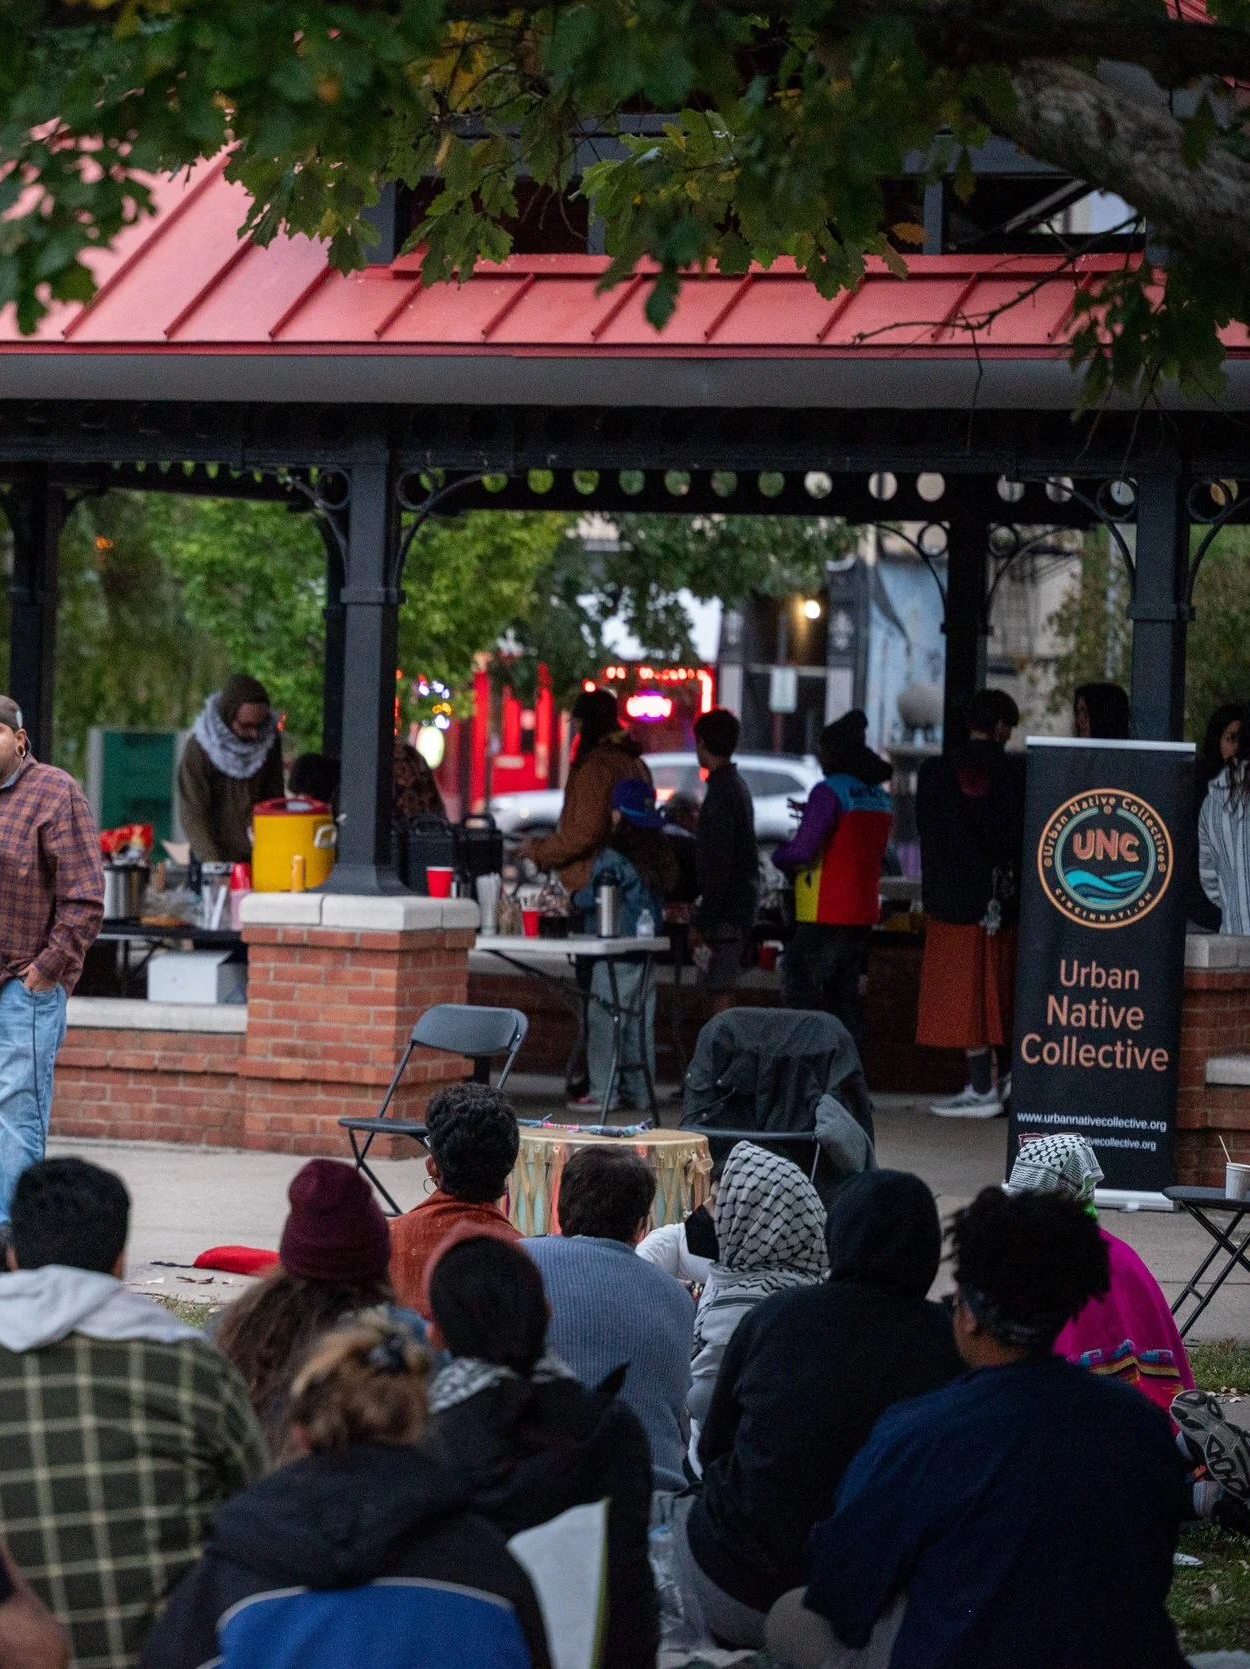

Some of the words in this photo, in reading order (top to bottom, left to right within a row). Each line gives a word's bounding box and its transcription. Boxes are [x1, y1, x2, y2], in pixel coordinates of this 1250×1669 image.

[1043, 814, 1068, 856] Urban
[1069, 795, 1116, 815] Native
[1122, 798, 1165, 862] Collective
[1073, 827, 1140, 862] UNC
[1060, 959, 1140, 990] Urban
[1047, 994, 1144, 1031] Native
[1021, 1032, 1169, 1072] Collective
[1017, 1112, 1167, 1132] www.urbannativecollective.org
